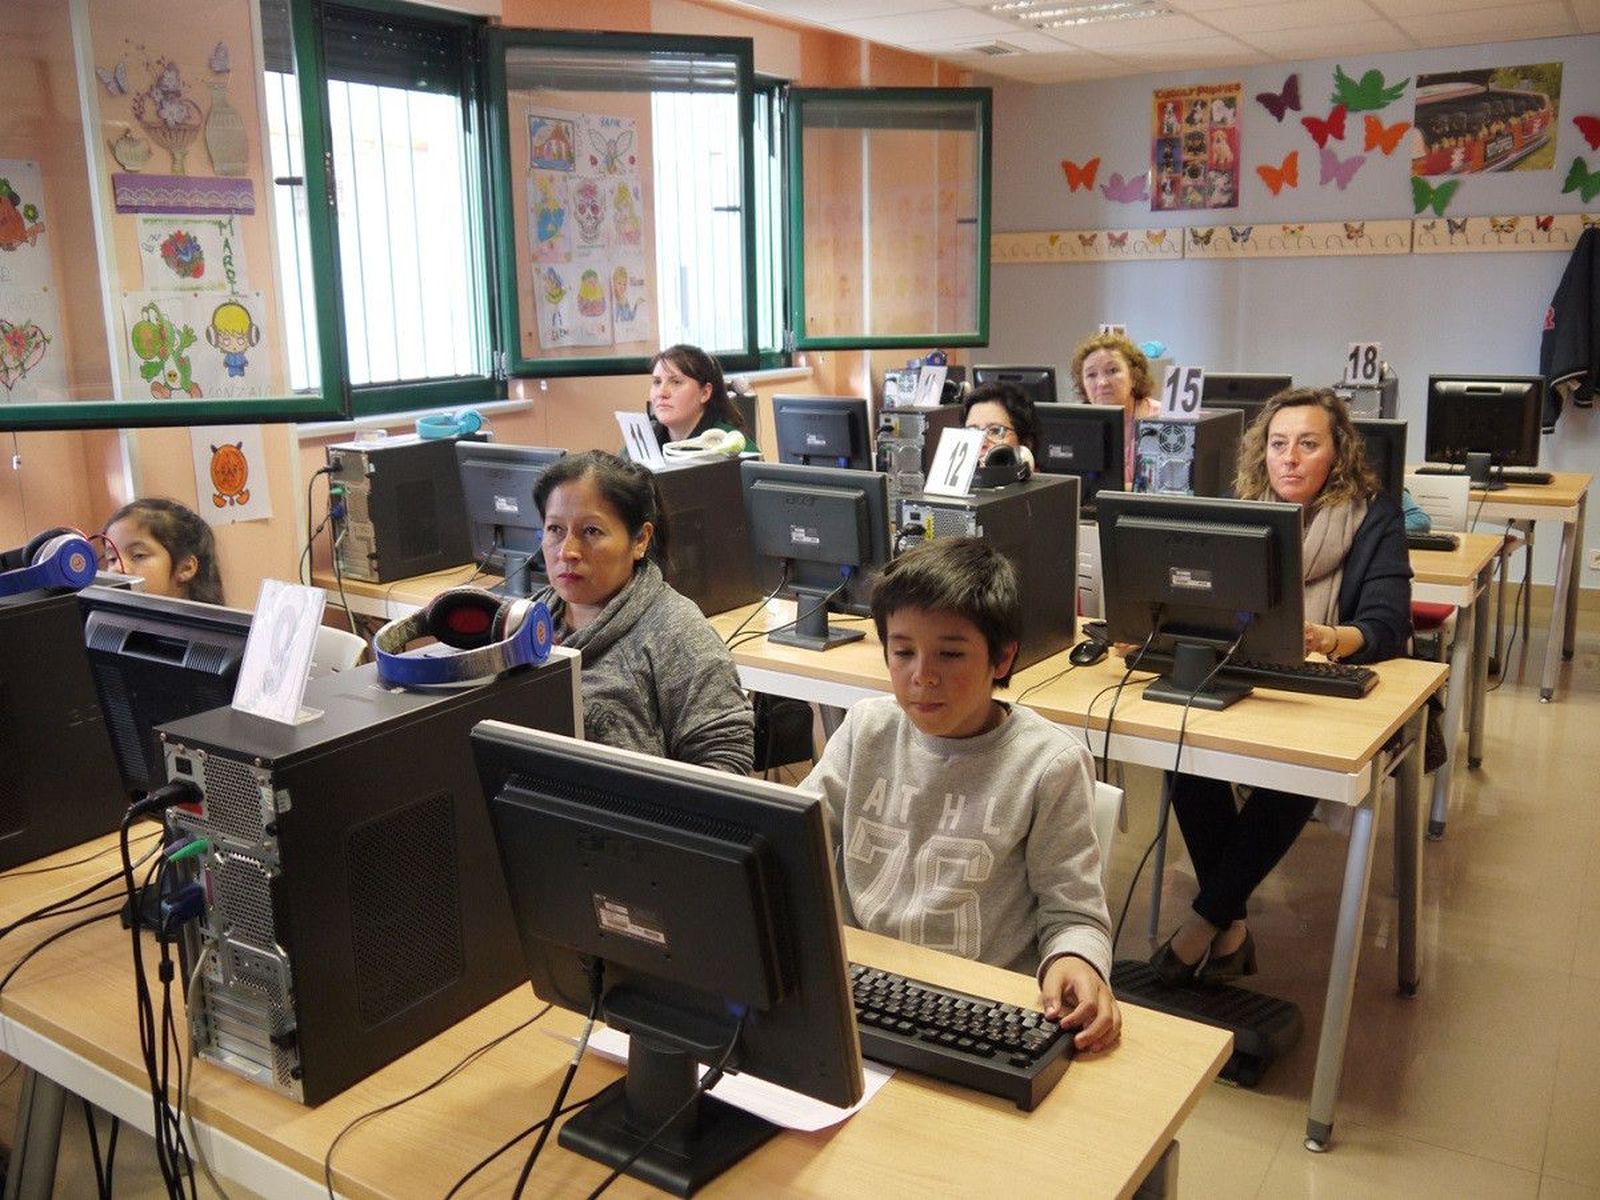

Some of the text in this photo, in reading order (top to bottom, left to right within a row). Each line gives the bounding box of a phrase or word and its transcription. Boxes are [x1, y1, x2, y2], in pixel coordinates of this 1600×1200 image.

[1348, 345, 1378, 380] 18
[1166, 367, 1202, 413] 15
[630, 423, 650, 460] 11
[943, 440, 969, 487] 12
[846, 818, 995, 960] 76
